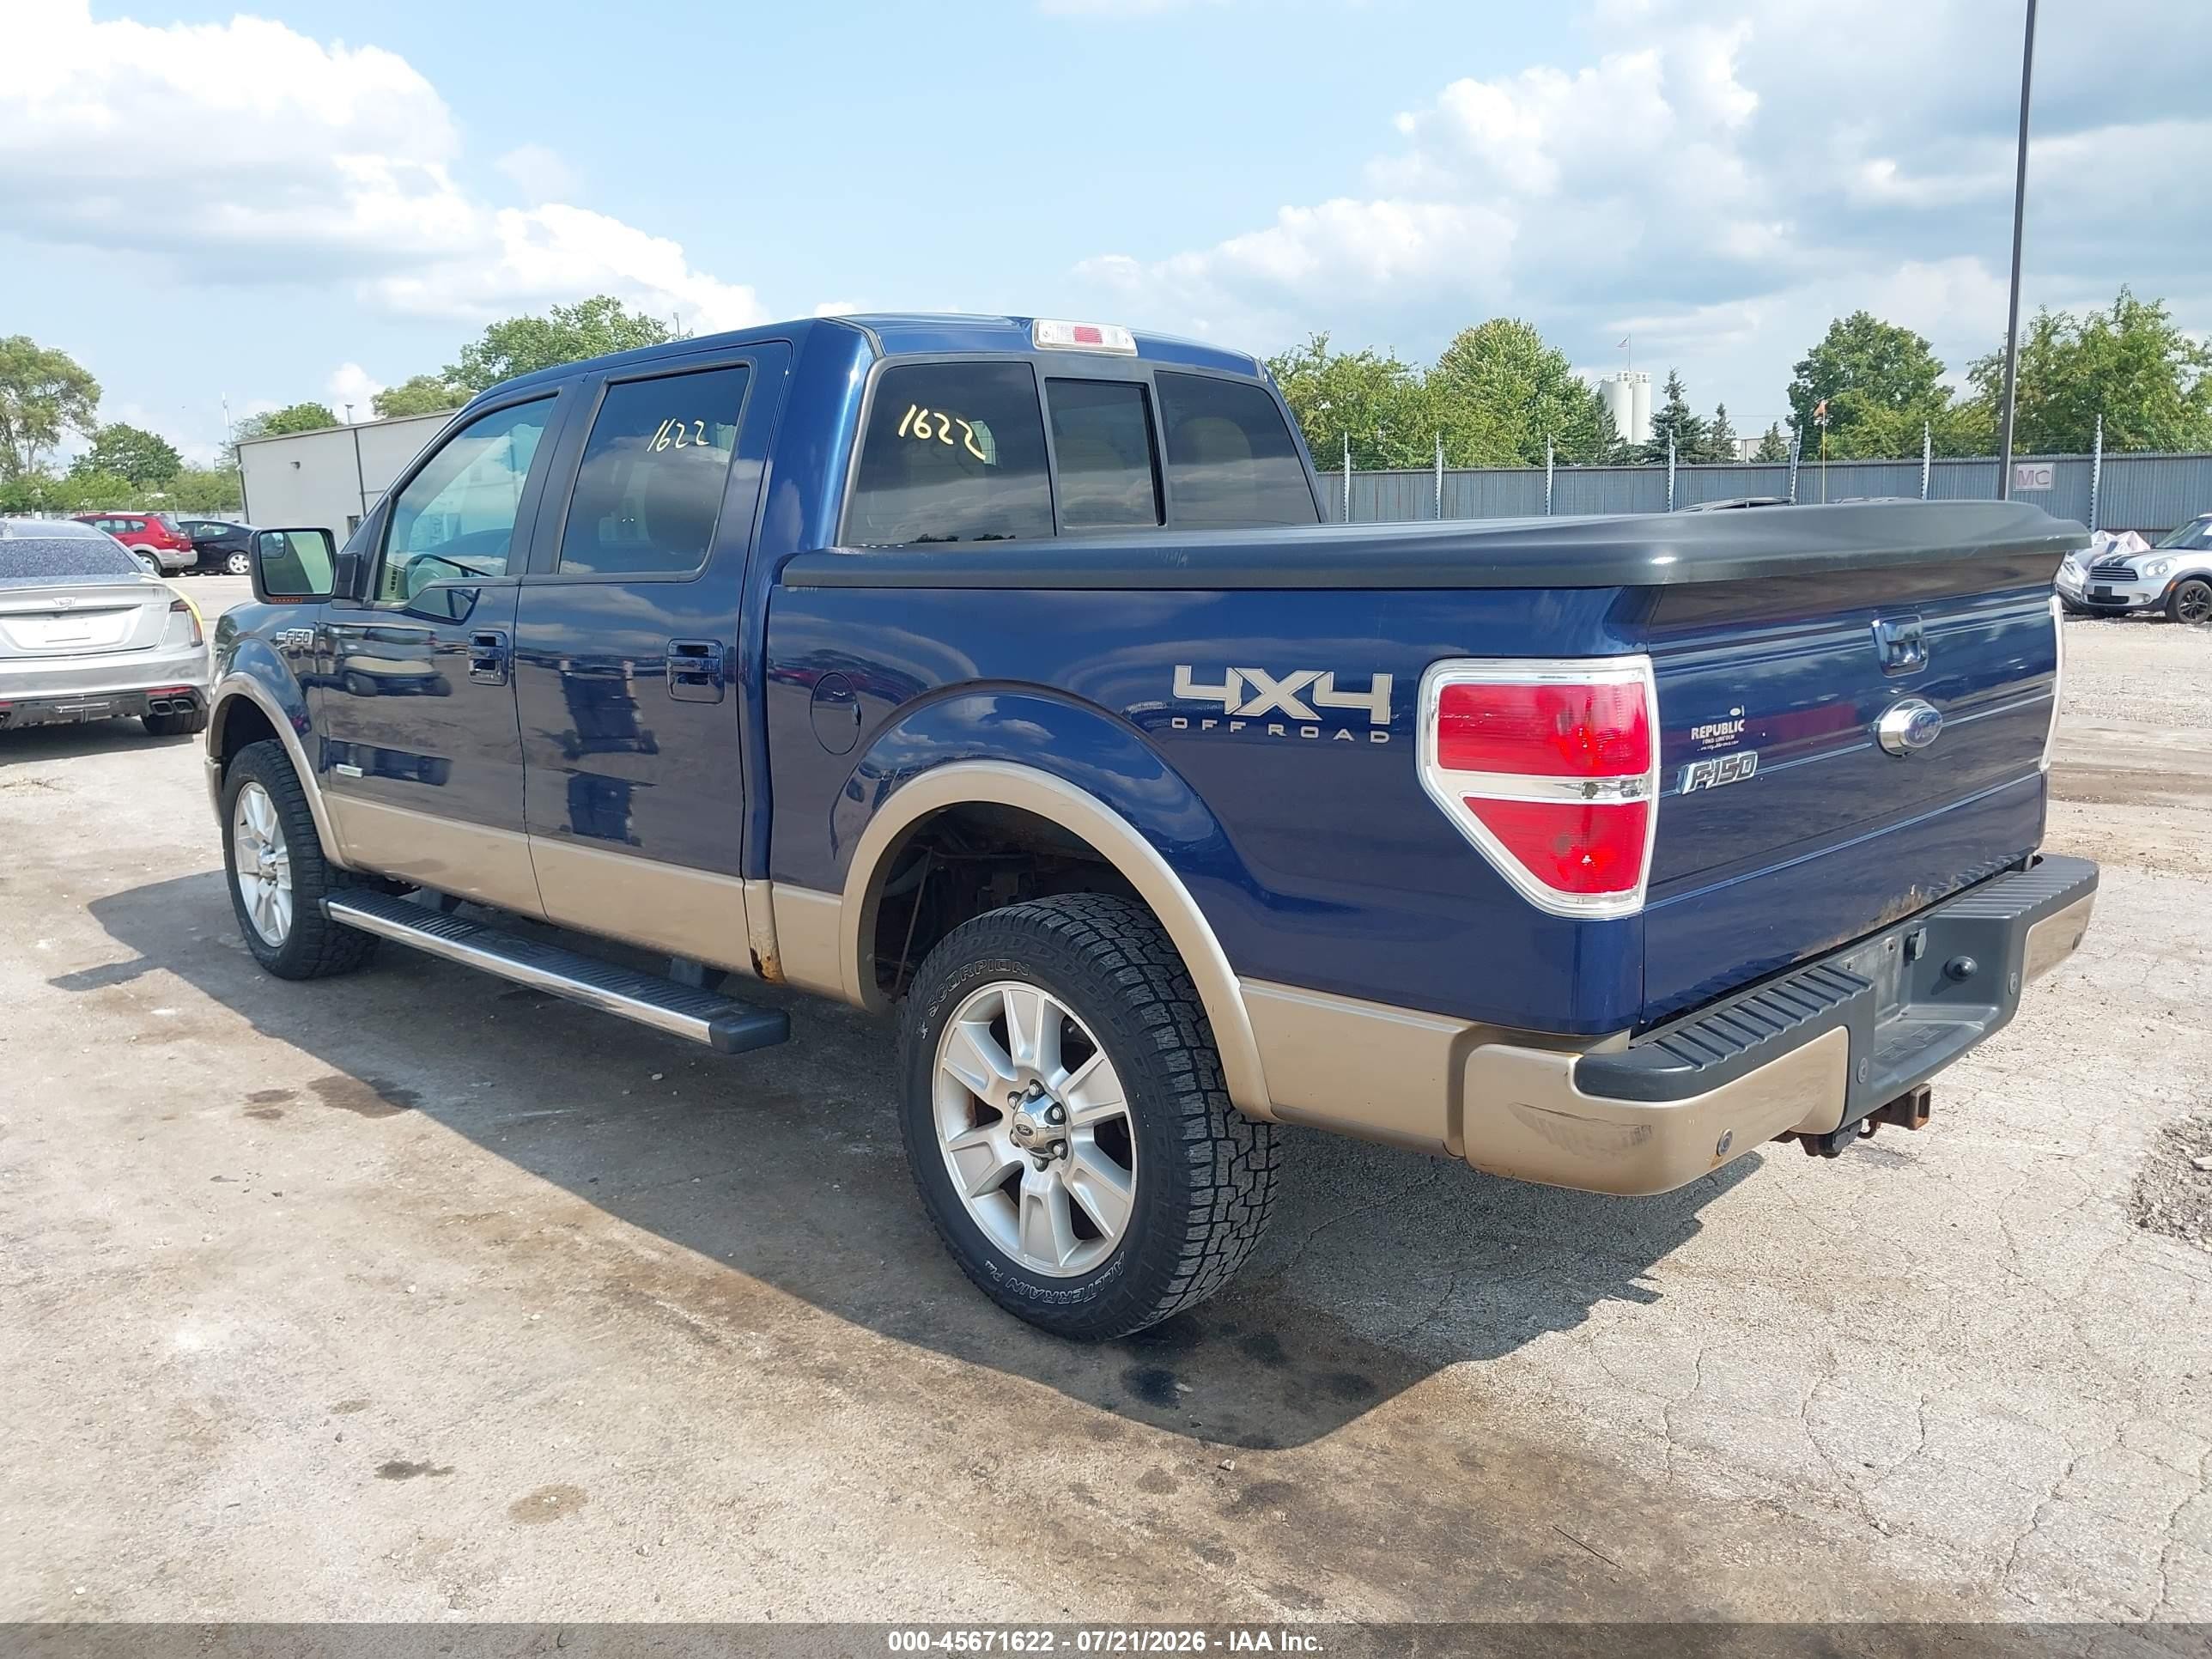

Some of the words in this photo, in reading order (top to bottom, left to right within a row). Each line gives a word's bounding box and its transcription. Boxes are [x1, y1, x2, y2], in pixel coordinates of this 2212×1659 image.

[647, 417, 711, 453] 1622
[898, 404, 986, 461] 1622
[2016, 470, 2051, 486] MC
[1171, 717, 1237, 733] OFF
[1267, 723, 1390, 744] ROAD
[1691, 719, 1746, 740] REPUBLIC
[927, 958, 1030, 1018] SCORPION
